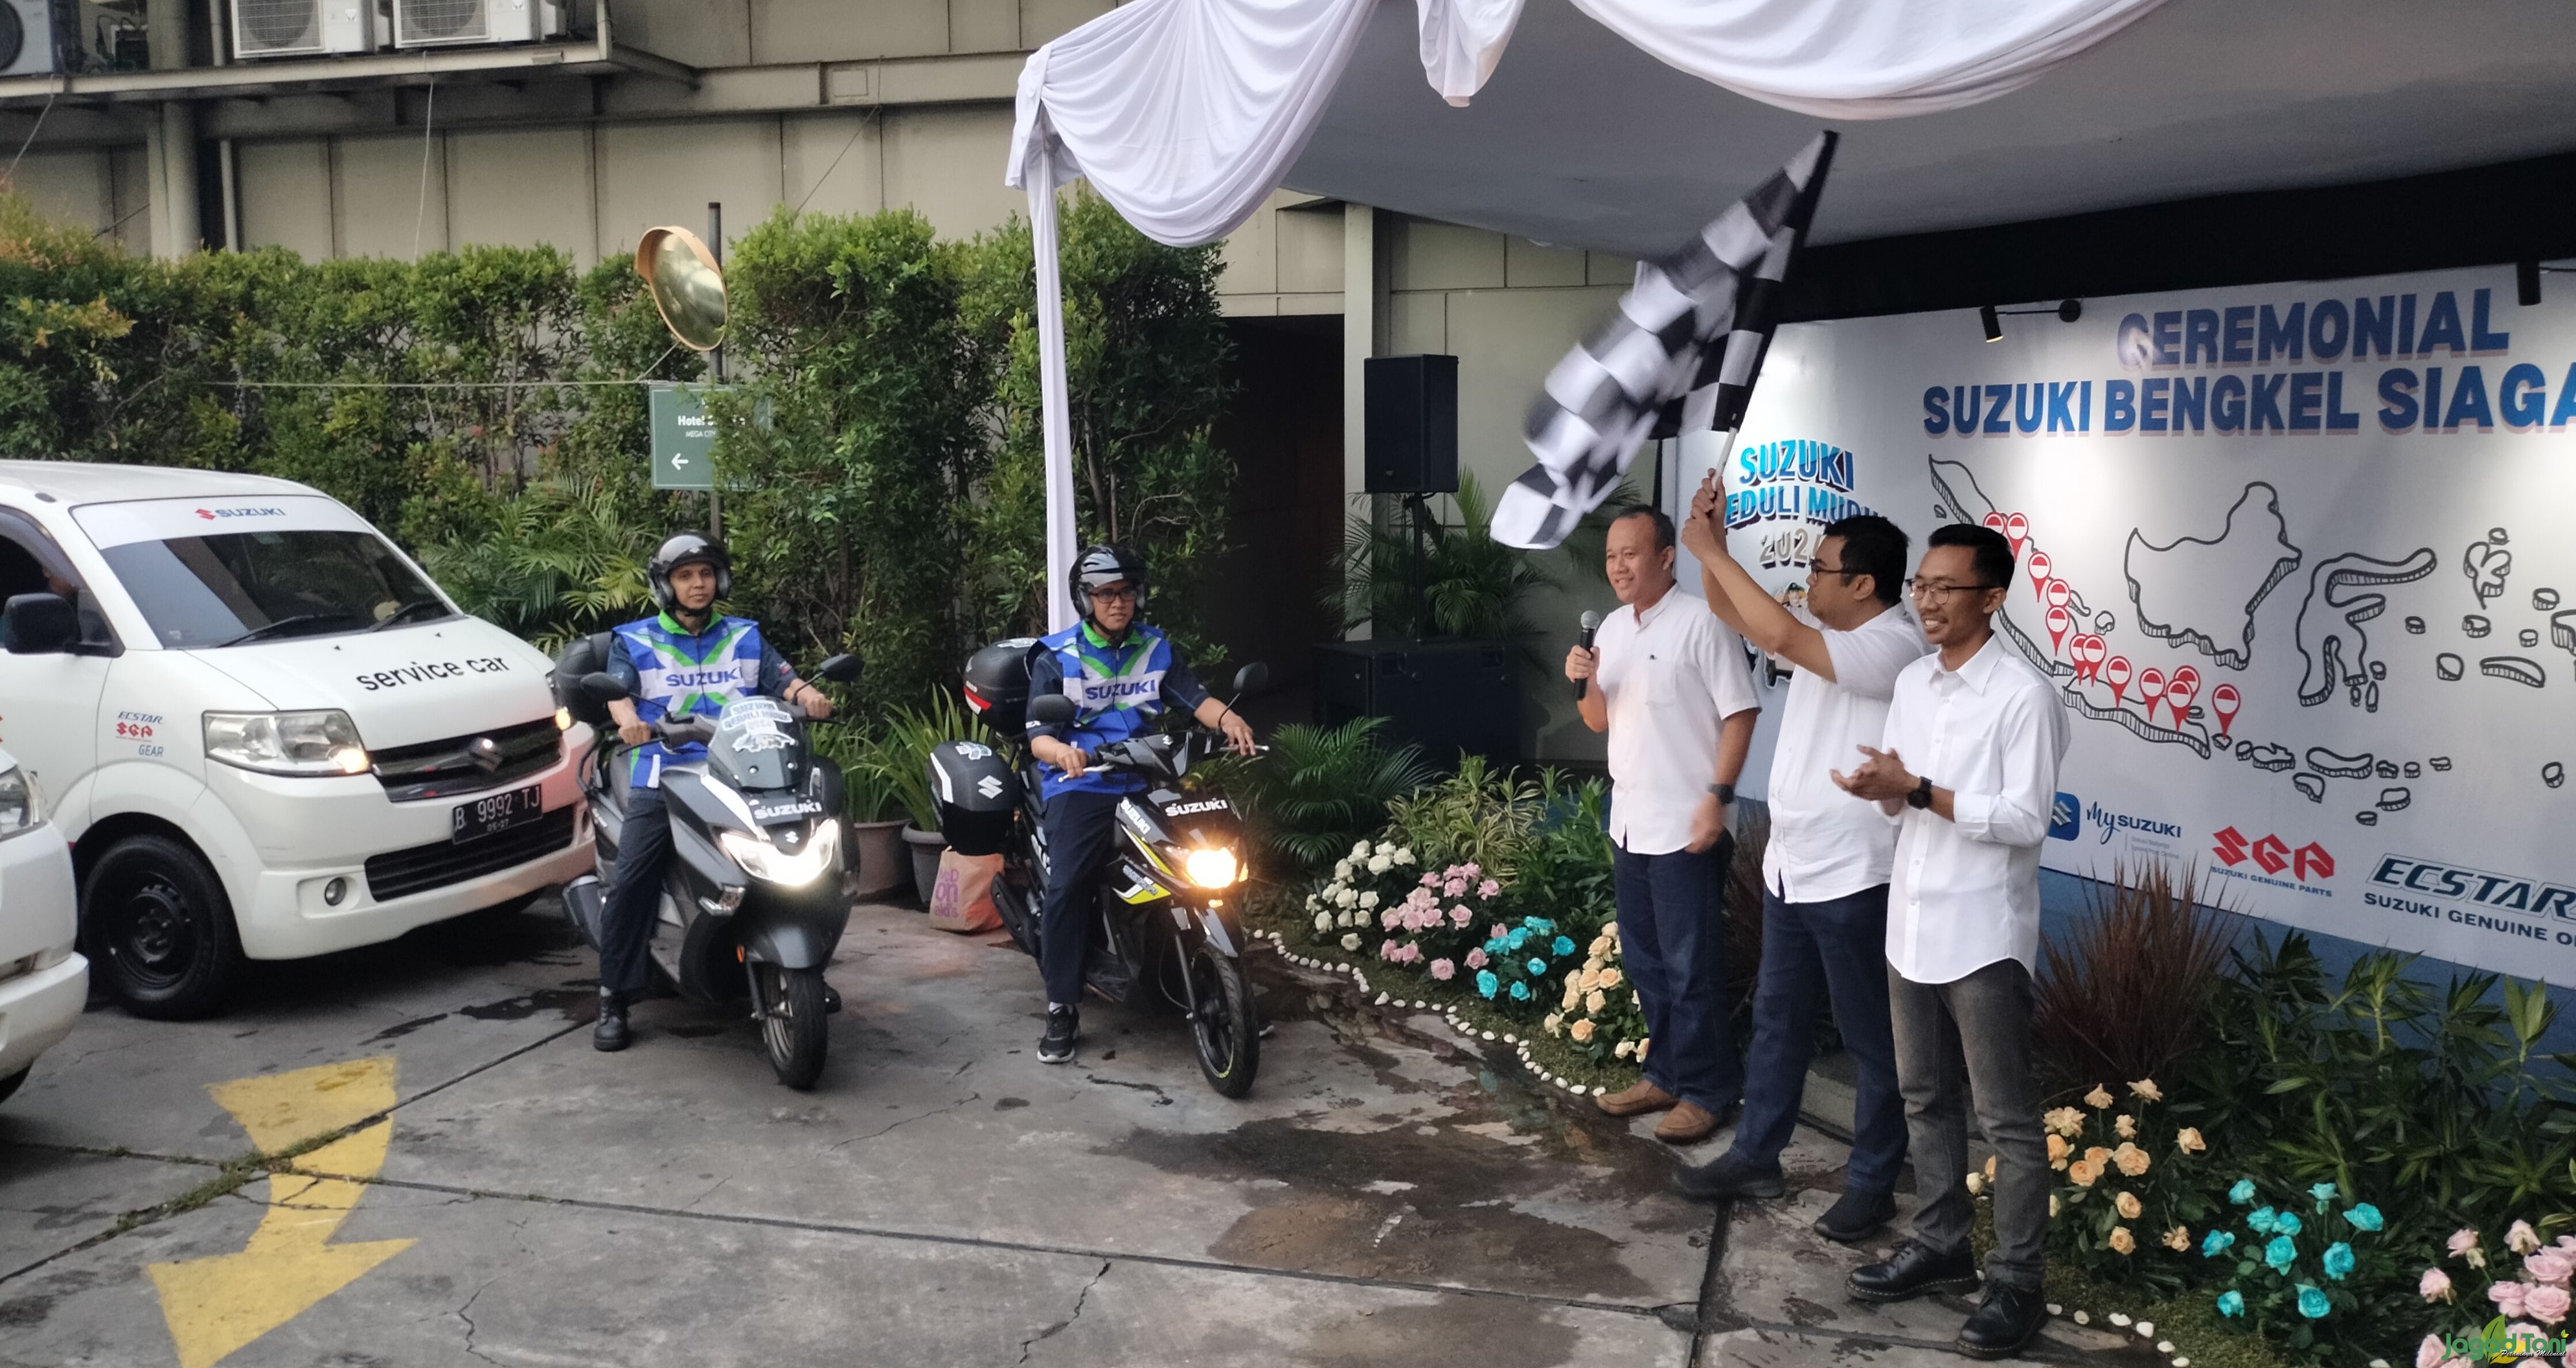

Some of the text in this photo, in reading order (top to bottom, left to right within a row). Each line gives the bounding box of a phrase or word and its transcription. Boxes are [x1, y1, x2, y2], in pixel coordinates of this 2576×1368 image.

[1923, 362, 2576, 435] SUZUKI BENGKEL SIAGA
[678, 415, 705, 426] Hotel
[1739, 439, 1855, 491] SUZUKI
[215, 508, 286, 518] SUZUKI
[1725, 484, 1878, 527] EDULI MUD
[356, 657, 510, 691] service car
[1085, 679, 1156, 700] SUZUKI
[118, 711, 163, 725] ECSTAR
[139, 744, 164, 758] GEAR
[455, 786, 540, 831] B 9992 TJ
[753, 801, 822, 819] SUZUKI
[1120, 799, 1151, 835] SUZUKI
[1165, 799, 1228, 817] SUZUKI
[2211, 865, 2332, 898] SUZUKI GENUINE PARTS
[2373, 858, 2576, 919] ECSTAR
[2364, 893, 2440, 918] SUZUKI
[2448, 909, 2548, 941] GENUINE
